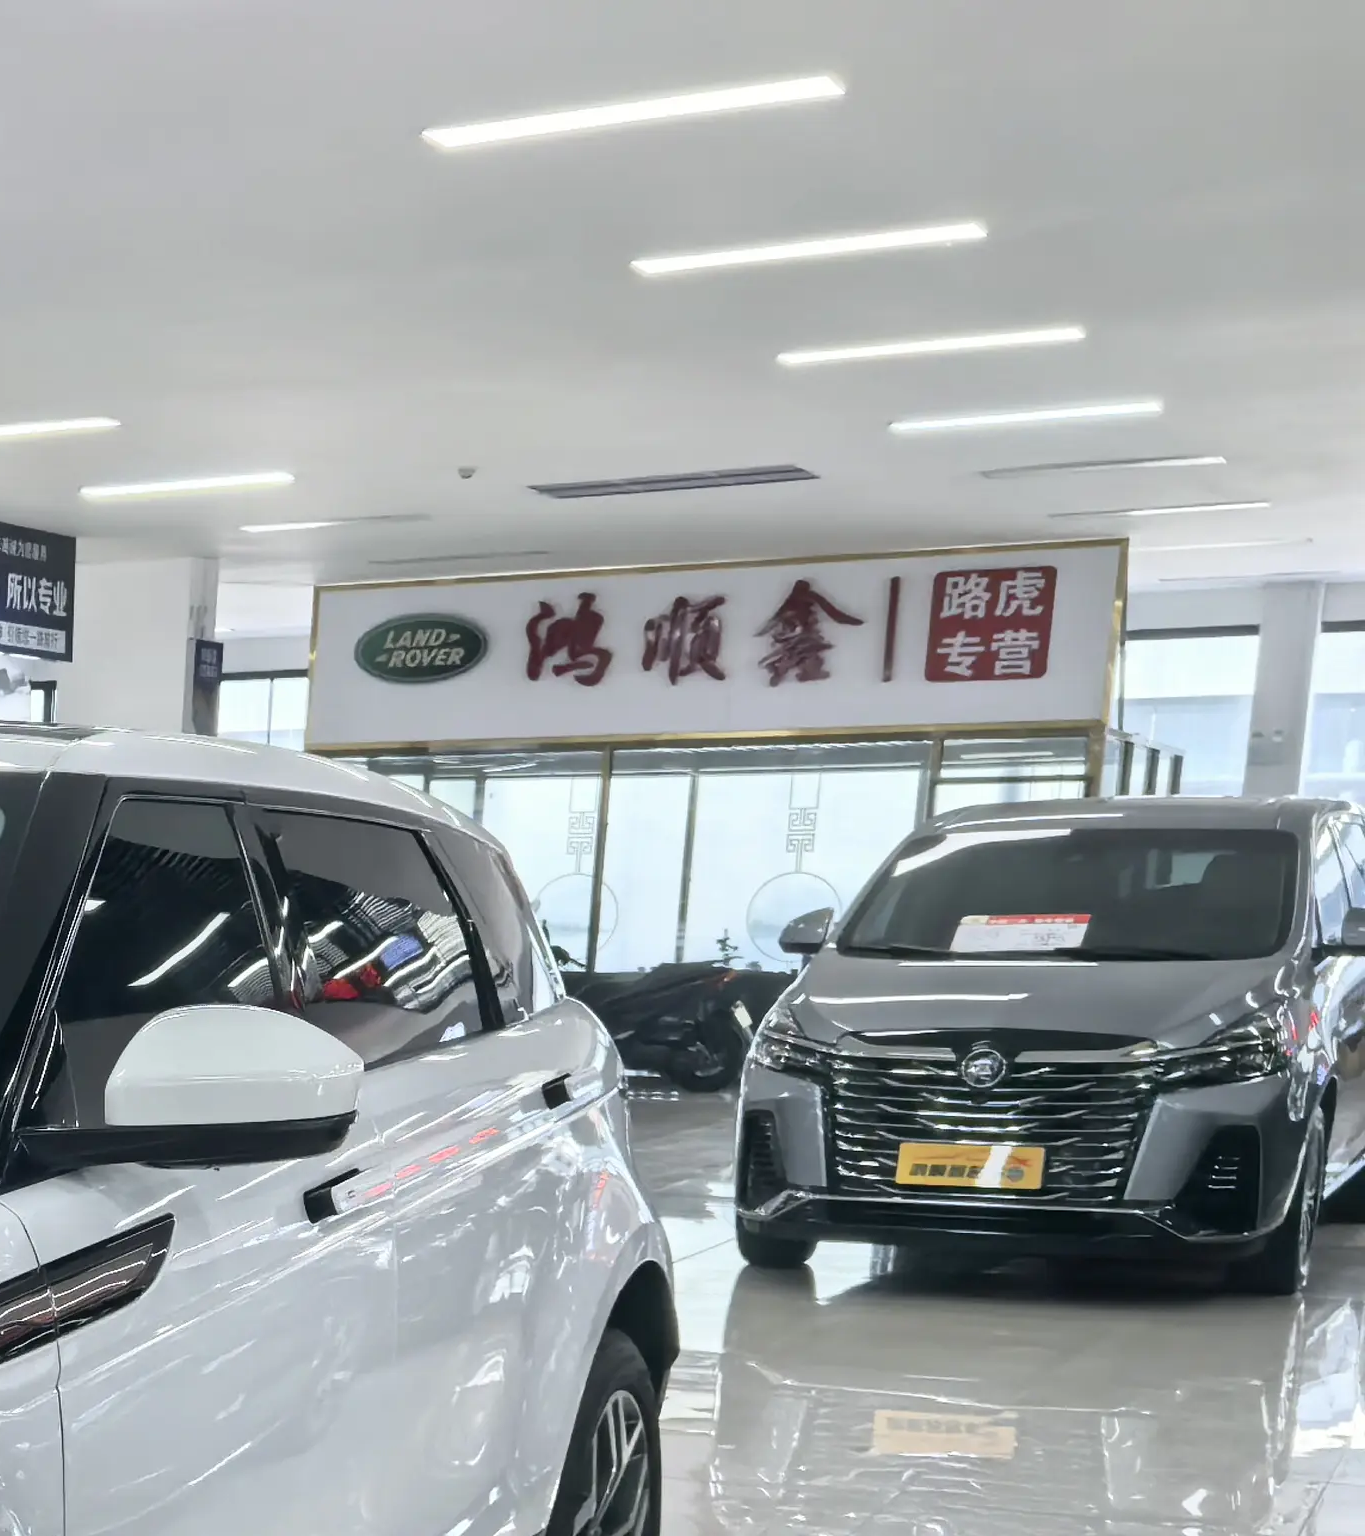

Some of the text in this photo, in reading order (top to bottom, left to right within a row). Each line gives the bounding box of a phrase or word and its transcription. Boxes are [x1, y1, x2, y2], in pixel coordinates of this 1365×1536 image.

[5, 572, 68, 617] 所以专业
[939, 568, 1047, 622] 路虎
[383, 628, 447, 650] LAND
[387, 646, 466, 668] ROVER
[525, 578, 866, 688] 鸿顺鑫
[934, 627, 1042, 679] 专营
